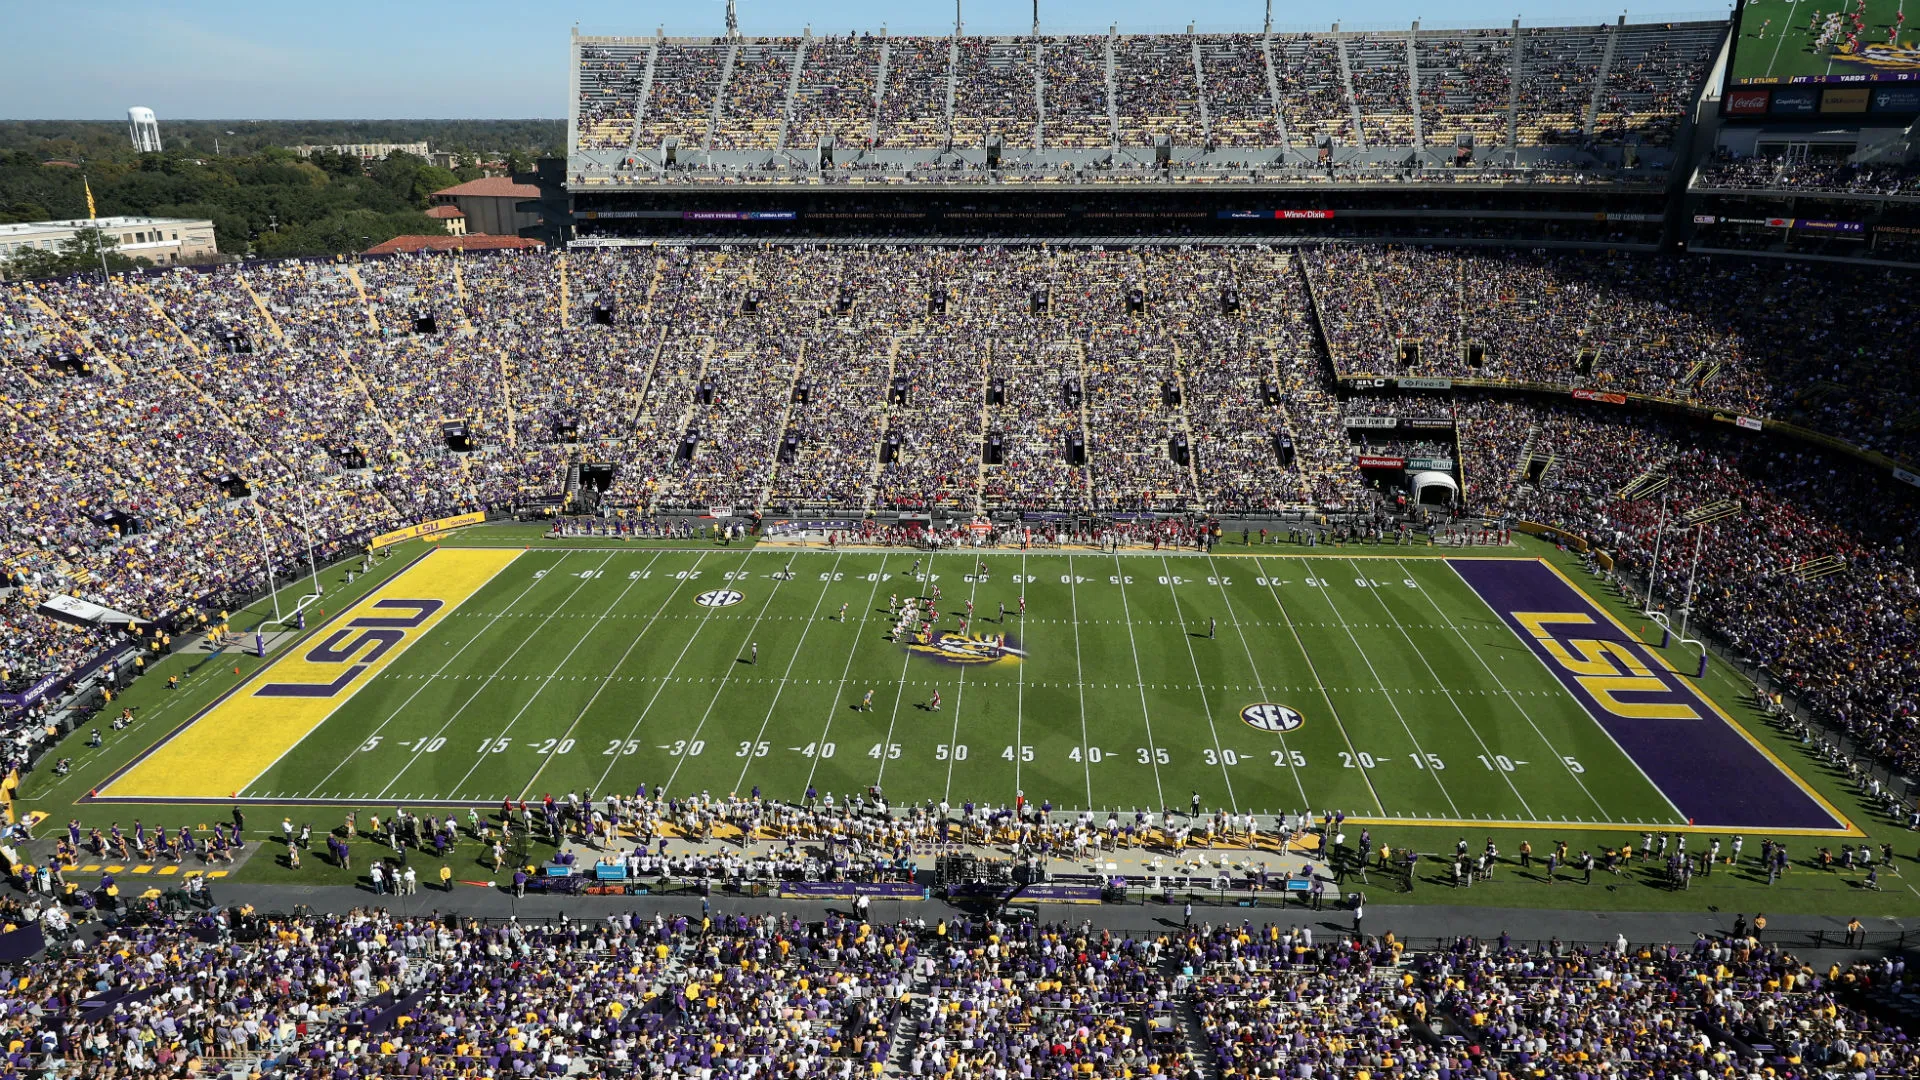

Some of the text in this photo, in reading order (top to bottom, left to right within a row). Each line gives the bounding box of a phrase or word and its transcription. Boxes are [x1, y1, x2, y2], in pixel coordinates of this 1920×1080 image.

[414, 522, 439, 535] LSU
[450, 518, 477, 526] GoDaddy
[532, 570, 549, 579] 5
[627, 570, 651, 579] 15
[675, 570, 702, 580] 20
[723, 571, 750, 580] 25
[818, 572, 845, 581] 35
[867, 572, 893, 582] 40
[915, 573, 941, 583] 45
[1012, 574, 1037, 584] 45
[1060, 575, 1086, 585] 40
[1109, 575, 1134, 585] 35
[1158, 575, 1181, 586] 30
[1206, 576, 1233, 586] 25
[1256, 576, 1283, 586] 20
[1304, 576, 1330, 588] 15
[1354, 577, 1380, 588] 10
[1402, 578, 1417, 588] 5
[699, 590, 741, 607] SEC
[253, 599, 445, 698] LSU
[1510, 611, 1702, 720] LSU
[24, 676, 56, 702] NISSAN
[1247, 704, 1300, 731] SEC
[361, 736, 383, 752] 5
[409, 736, 448, 753] 10
[476, 737, 512, 753] 15
[536, 738, 576, 754] 20
[603, 739, 641, 754] 25
[668, 740, 705, 756] 30
[736, 741, 770, 757] 35
[802, 742, 836, 758] 40
[868, 744, 902, 760] 45
[935, 745, 968, 761] 50
[1001, 746, 1034, 762] 45
[1069, 746, 1101, 763] 40
[1137, 747, 1169, 764] 35
[1204, 748, 1237, 766] 30
[1271, 750, 1306, 767] 25
[1338, 751, 1376, 768] 20
[1409, 753, 1445, 770] 15
[1477, 755, 1516, 772] 10
[1562, 756, 1585, 773] 5
